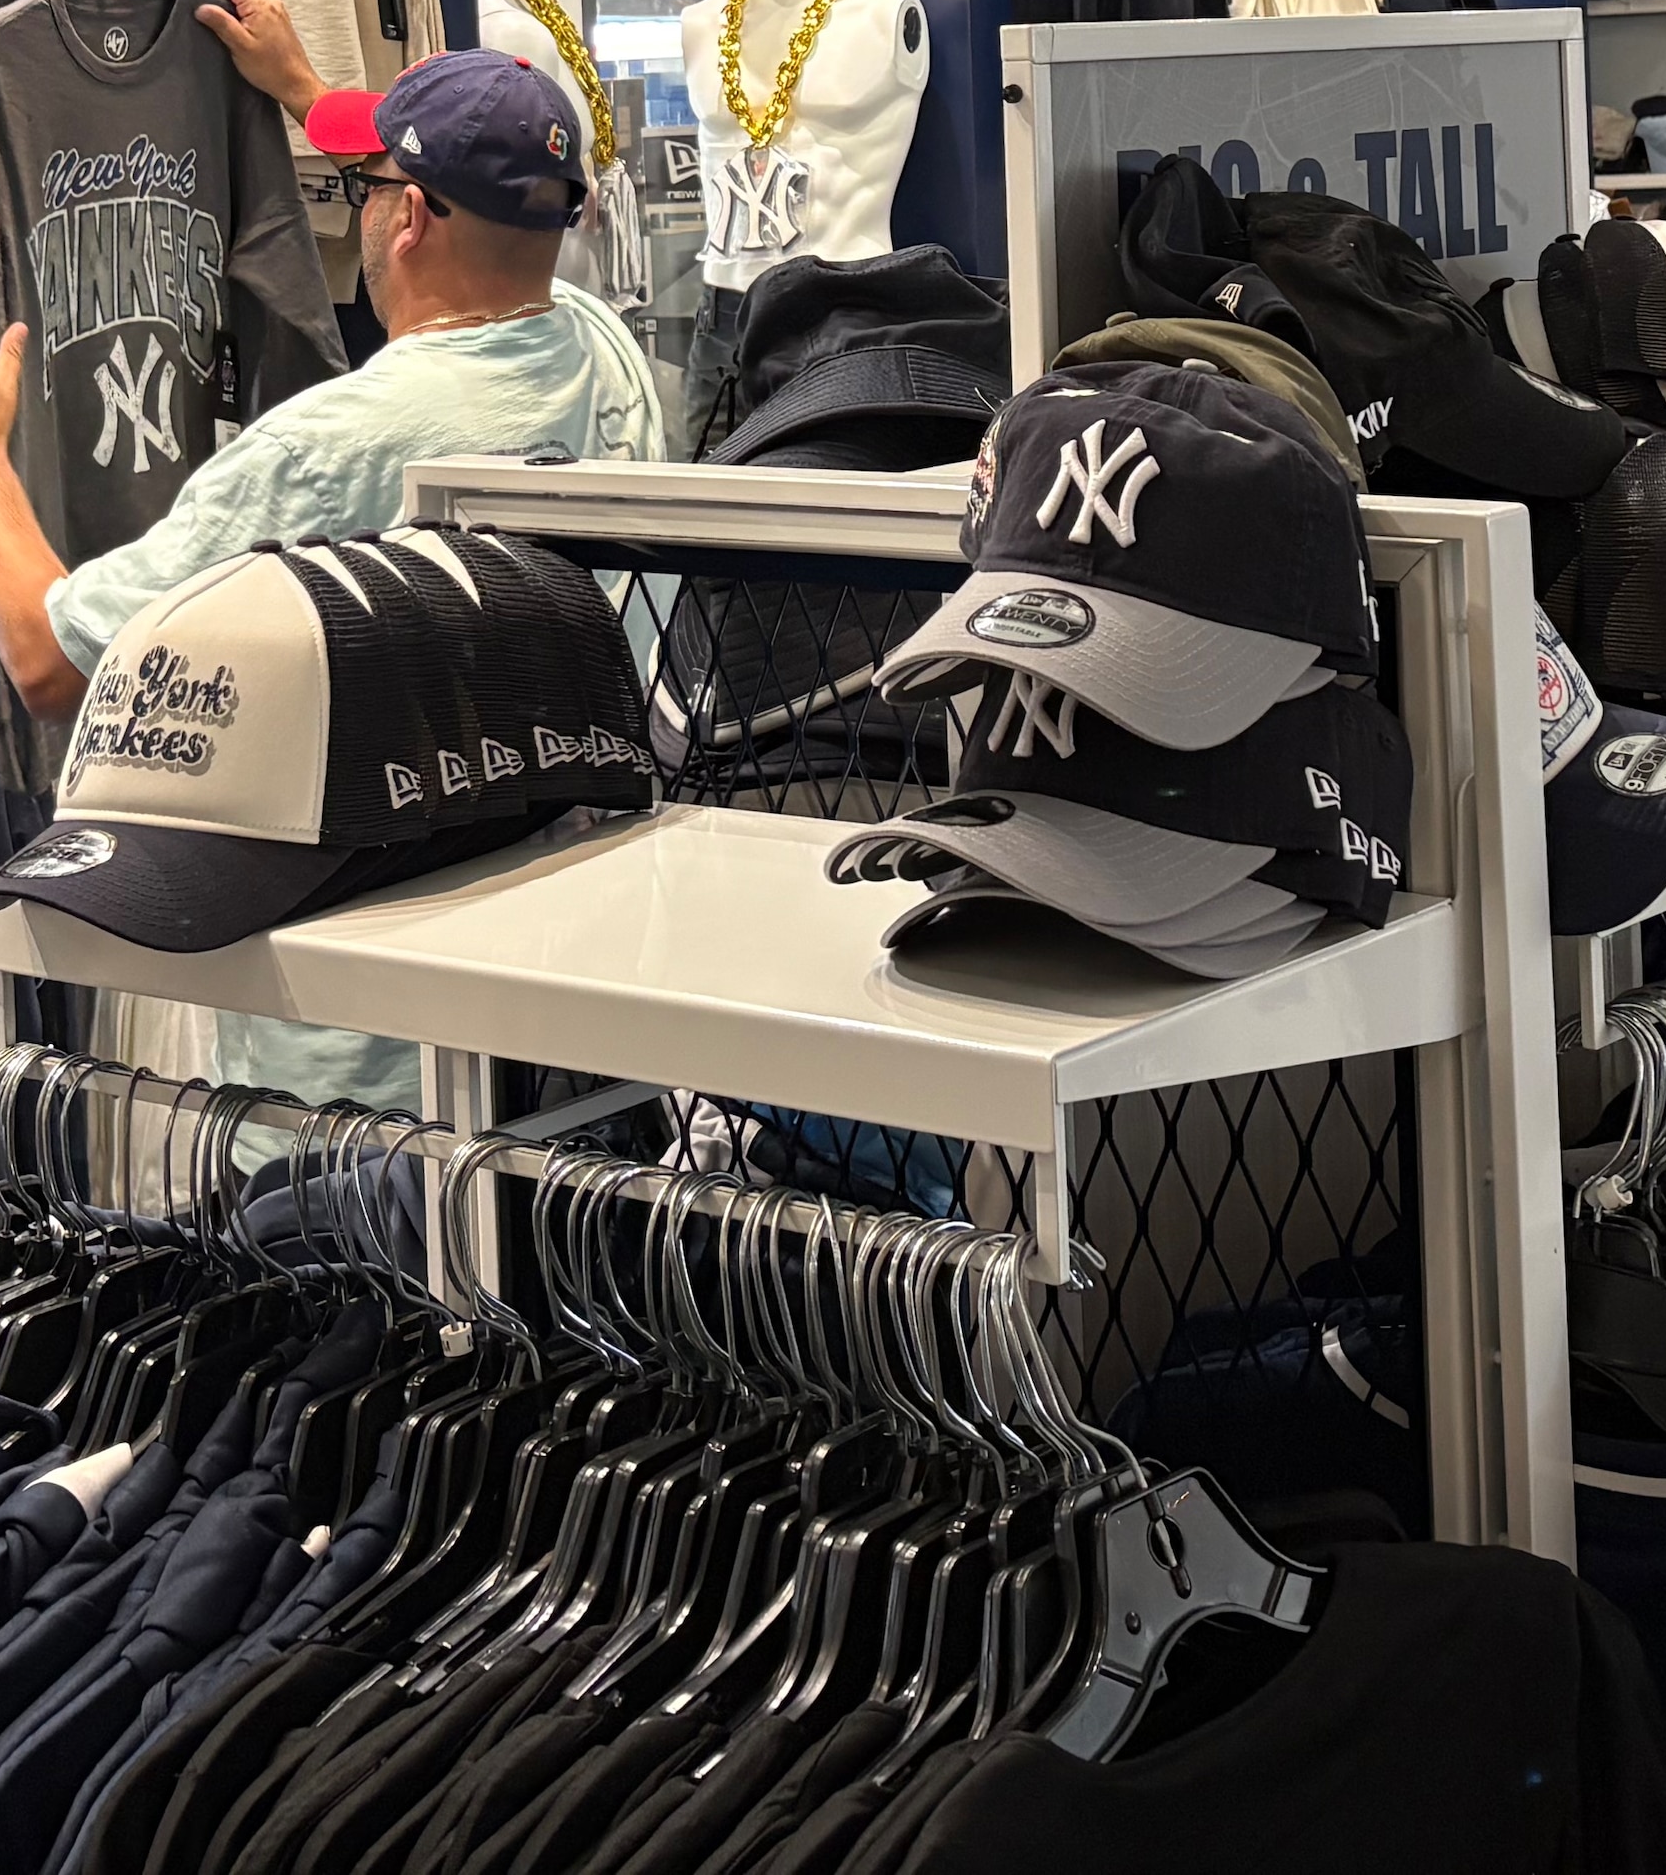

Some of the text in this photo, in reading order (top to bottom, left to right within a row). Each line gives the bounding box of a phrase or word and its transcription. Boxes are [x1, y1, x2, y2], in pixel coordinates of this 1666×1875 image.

[43, 134, 197, 209] New York
[1354, 123, 1509, 261] TALL
[133, 645, 235, 725] York
